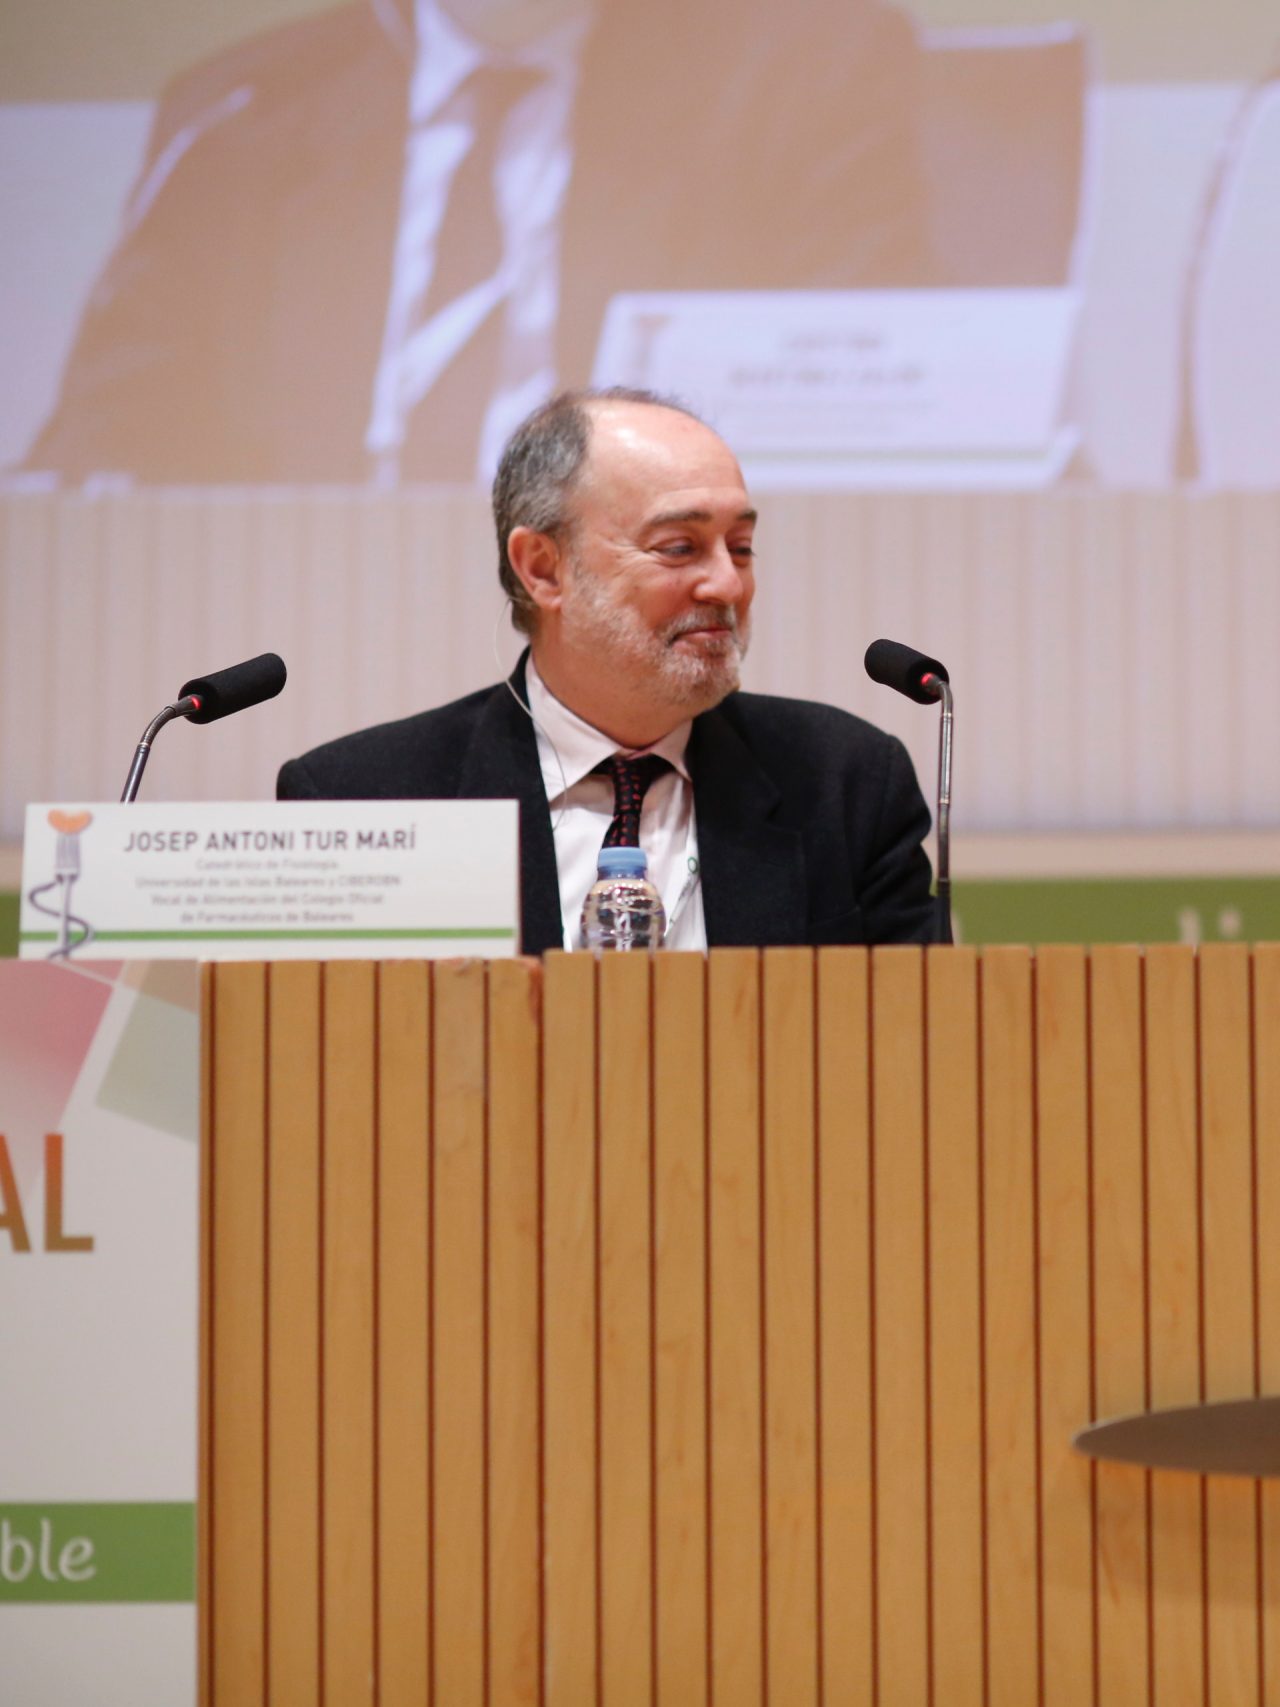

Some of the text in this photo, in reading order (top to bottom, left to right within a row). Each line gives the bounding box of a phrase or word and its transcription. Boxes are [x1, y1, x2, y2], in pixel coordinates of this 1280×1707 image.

[123, 823, 417, 852] JOSEP ANTONI TUR MARÍ
